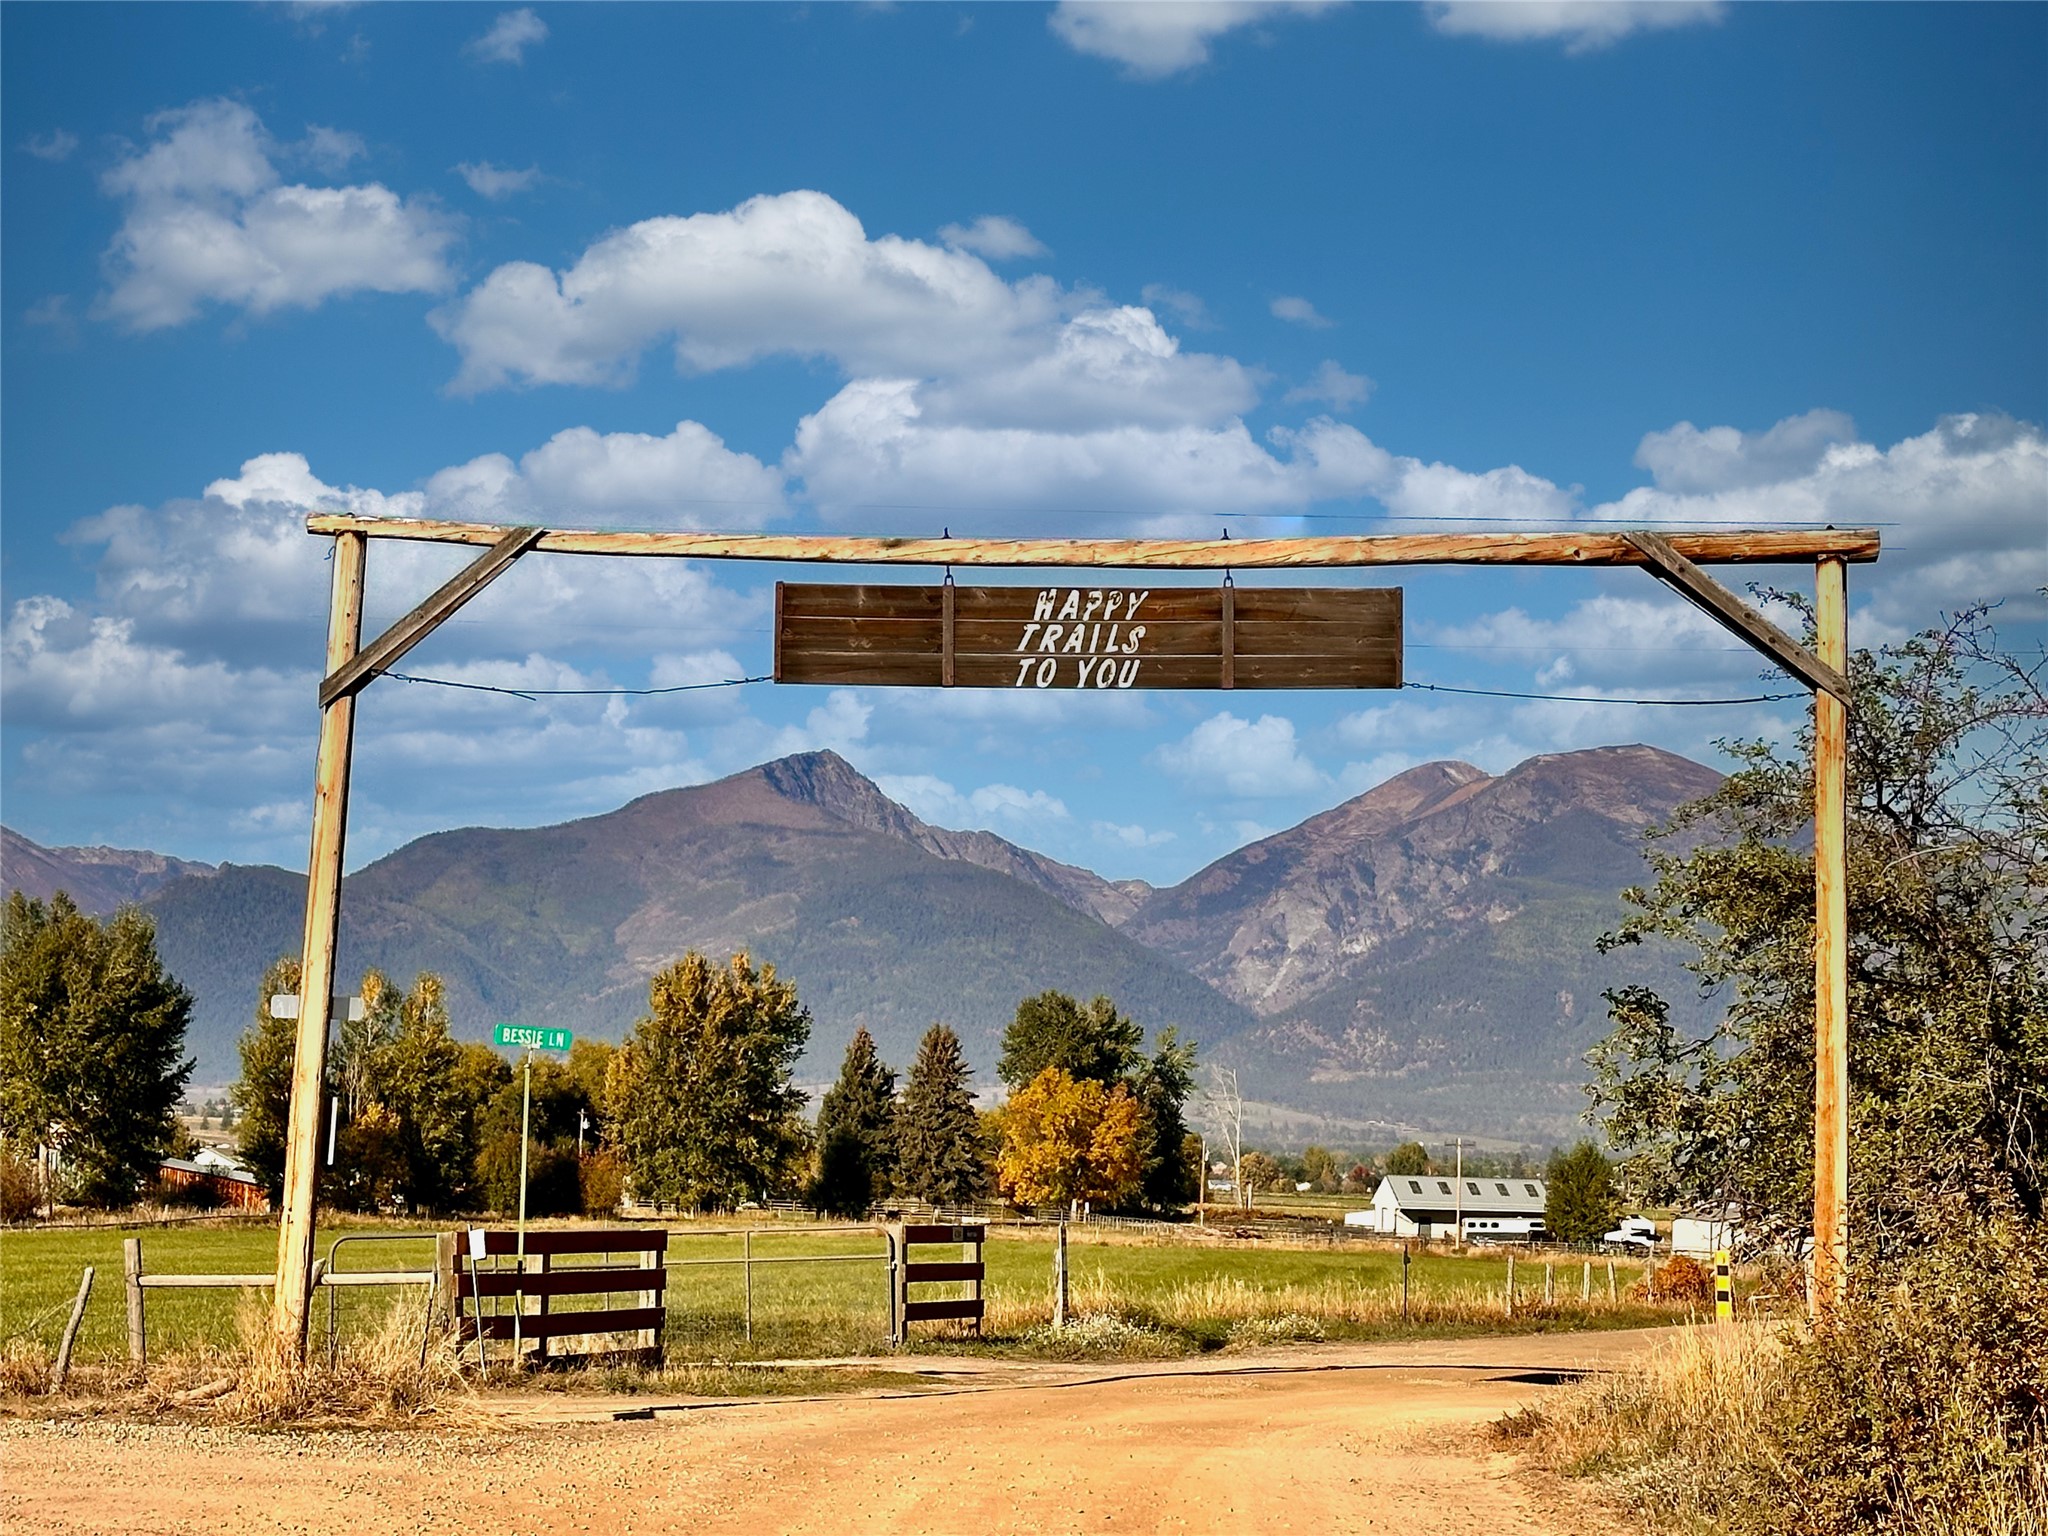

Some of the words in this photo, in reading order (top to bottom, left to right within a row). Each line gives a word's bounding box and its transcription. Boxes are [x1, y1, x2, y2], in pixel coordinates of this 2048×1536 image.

[1033, 589, 1149, 621] HAPPY
[1016, 623, 1146, 654] TRAILS
[1015, 657, 1057, 688] TO
[1077, 656, 1140, 688] YOU
[502, 1027, 544, 1046] BESSIE
[548, 1032, 565, 1047] LN
